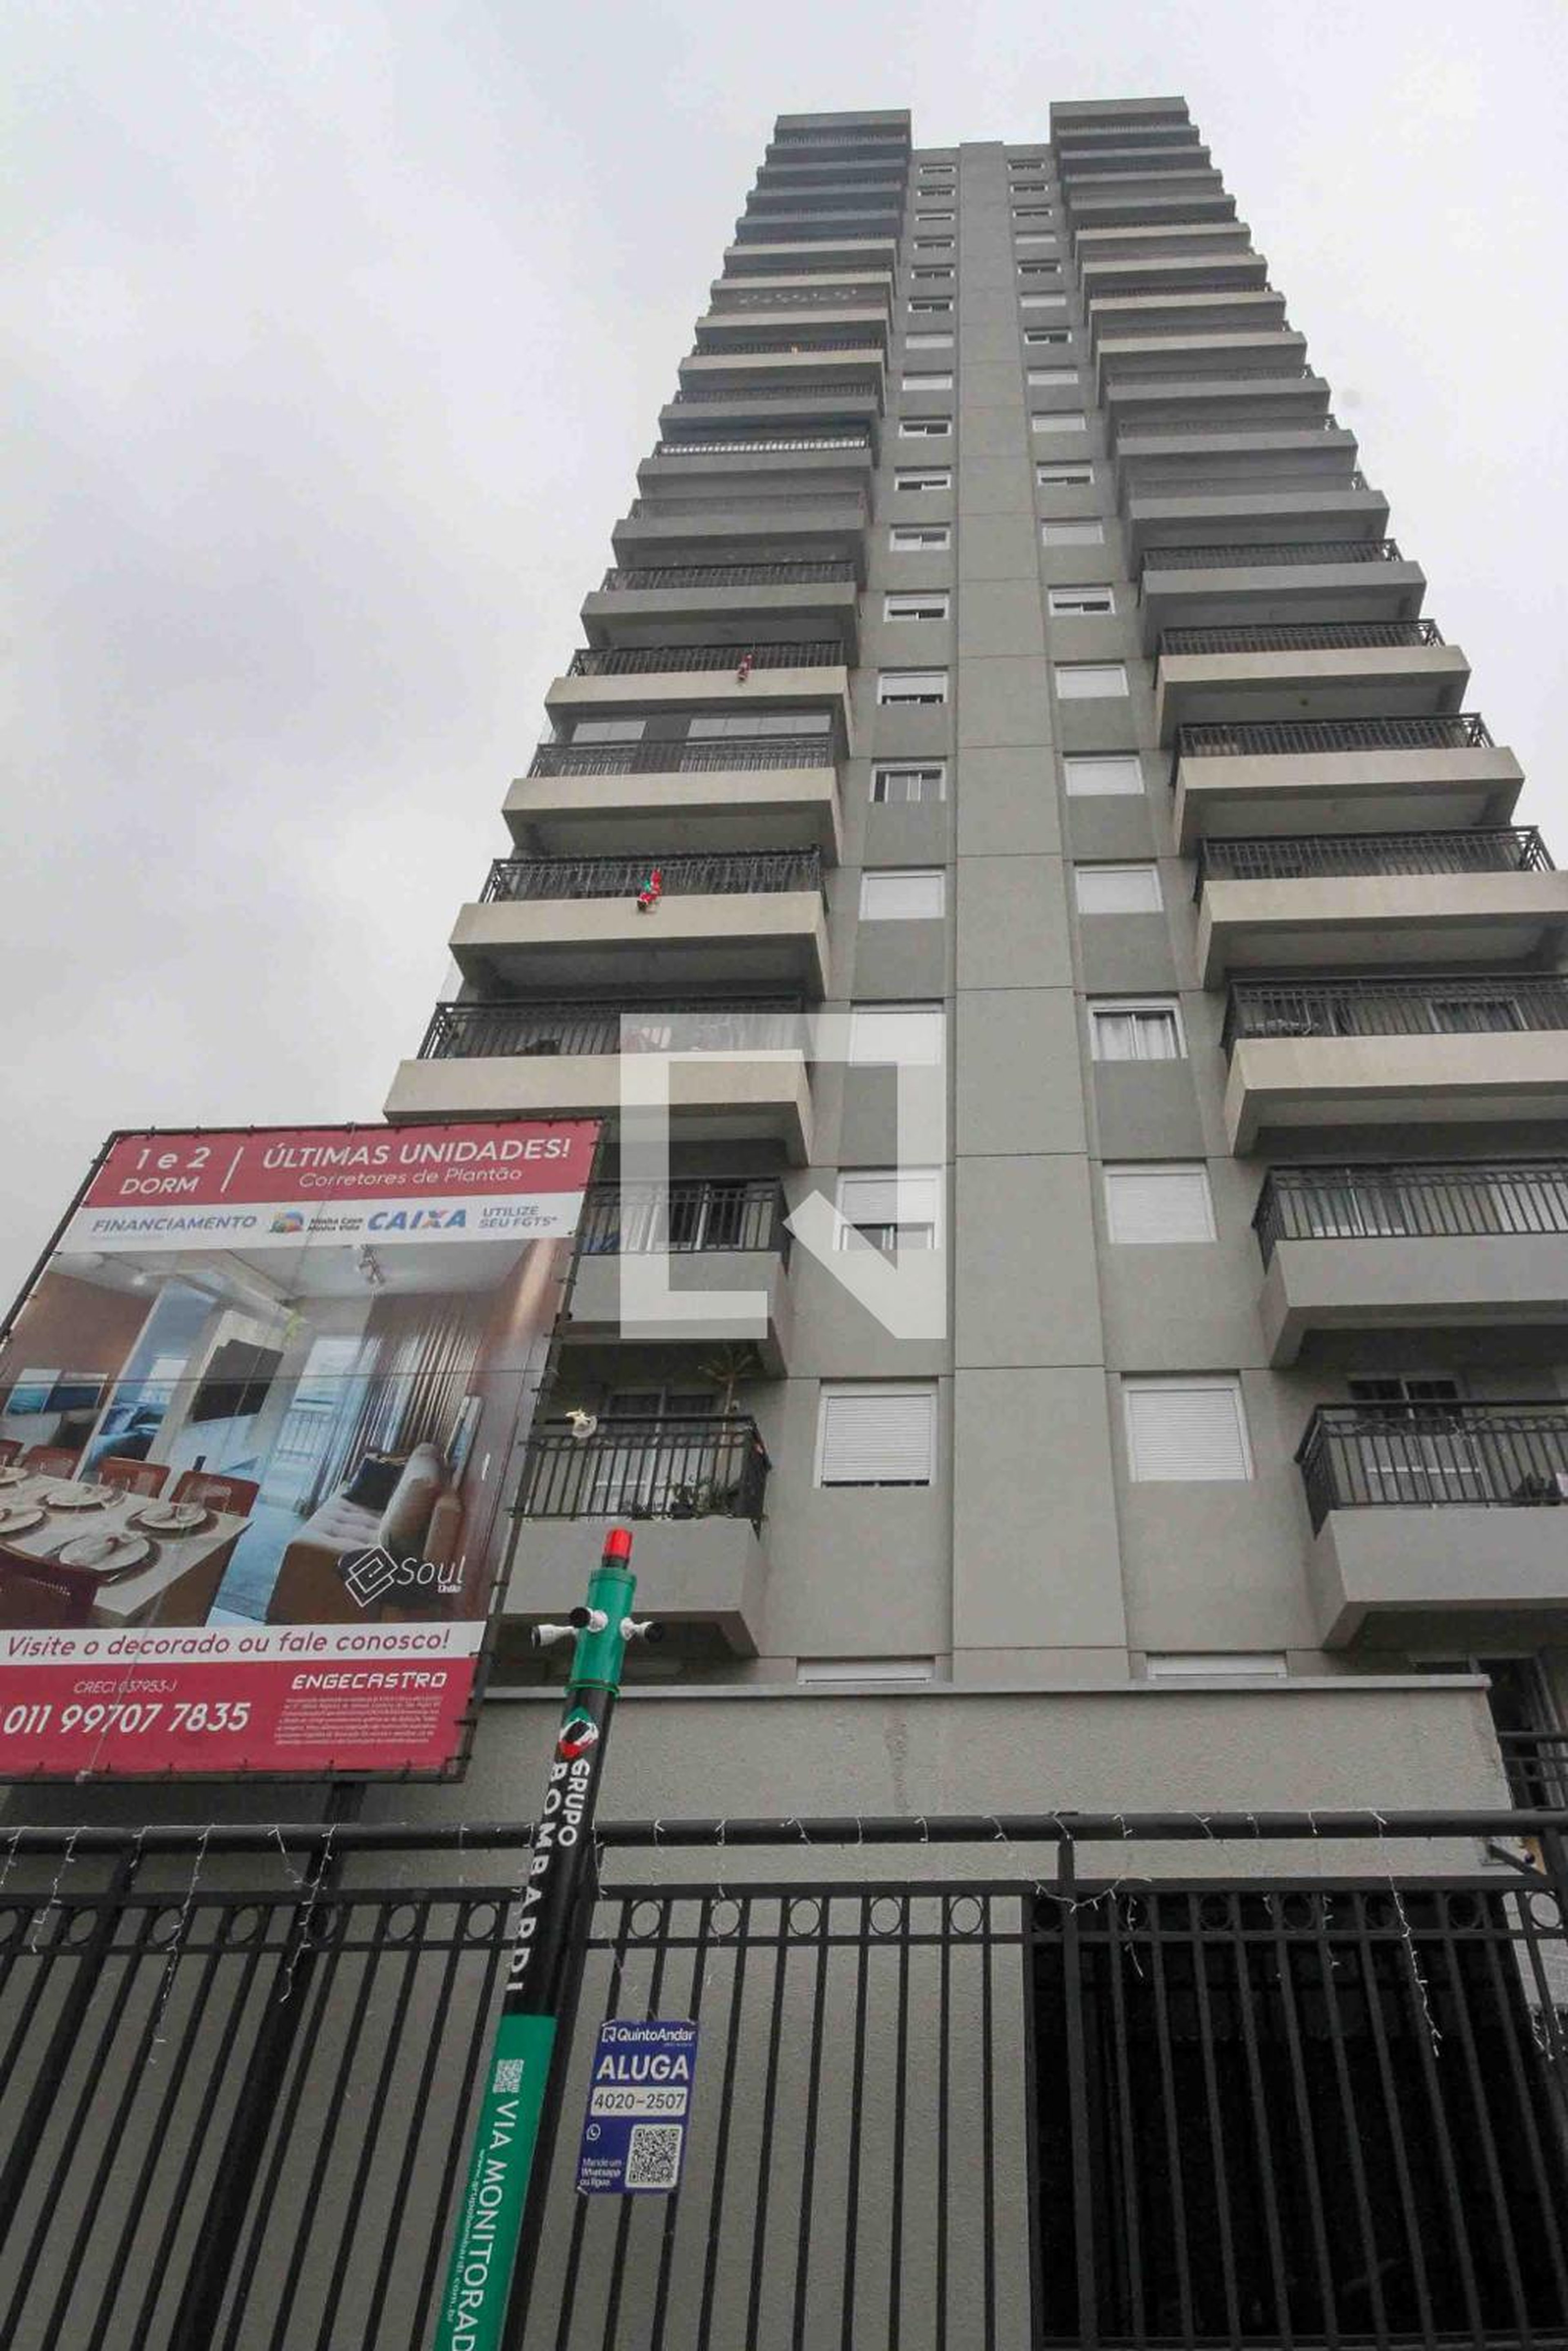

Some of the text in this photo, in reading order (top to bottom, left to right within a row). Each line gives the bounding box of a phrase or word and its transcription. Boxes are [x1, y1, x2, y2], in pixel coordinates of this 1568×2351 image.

[136, 1147, 210, 1170] 1 e 2
[263, 1138, 571, 1169] ÚLTIMAS UNIDADES!
[120, 1177, 199, 1195] DORM
[299, 1167, 522, 1188] Corretores de Plantão
[368, 1209, 467, 1230] CAIXA
[483, 1206, 539, 1217] UTILIZE
[91, 1215, 258, 1233] FINANCIAMENTO
[478, 1217, 512, 1229] SEU
[397, 1555, 466, 1585] Soul
[8, 1629, 450, 1657] Visite o decorado ou fale conosco!
[73, 1680, 117, 1694] CRECI
[291, 1672, 448, 1690] ENGECASTRO
[3, 1704, 52, 1734] 011
[60, 1703, 163, 1733] 99707
[167, 1702, 251, 1732] 7835
[558, 1759, 590, 1847] GRUPO
[506, 1762, 568, 1991] BOMBARDI
[617, 2028, 696, 2041] QuintoAndar
[596, 2054, 689, 2081] ALUGA
[594, 2092, 685, 2110] 4020-2507
[490, 2099, 519, 2150] VIA
